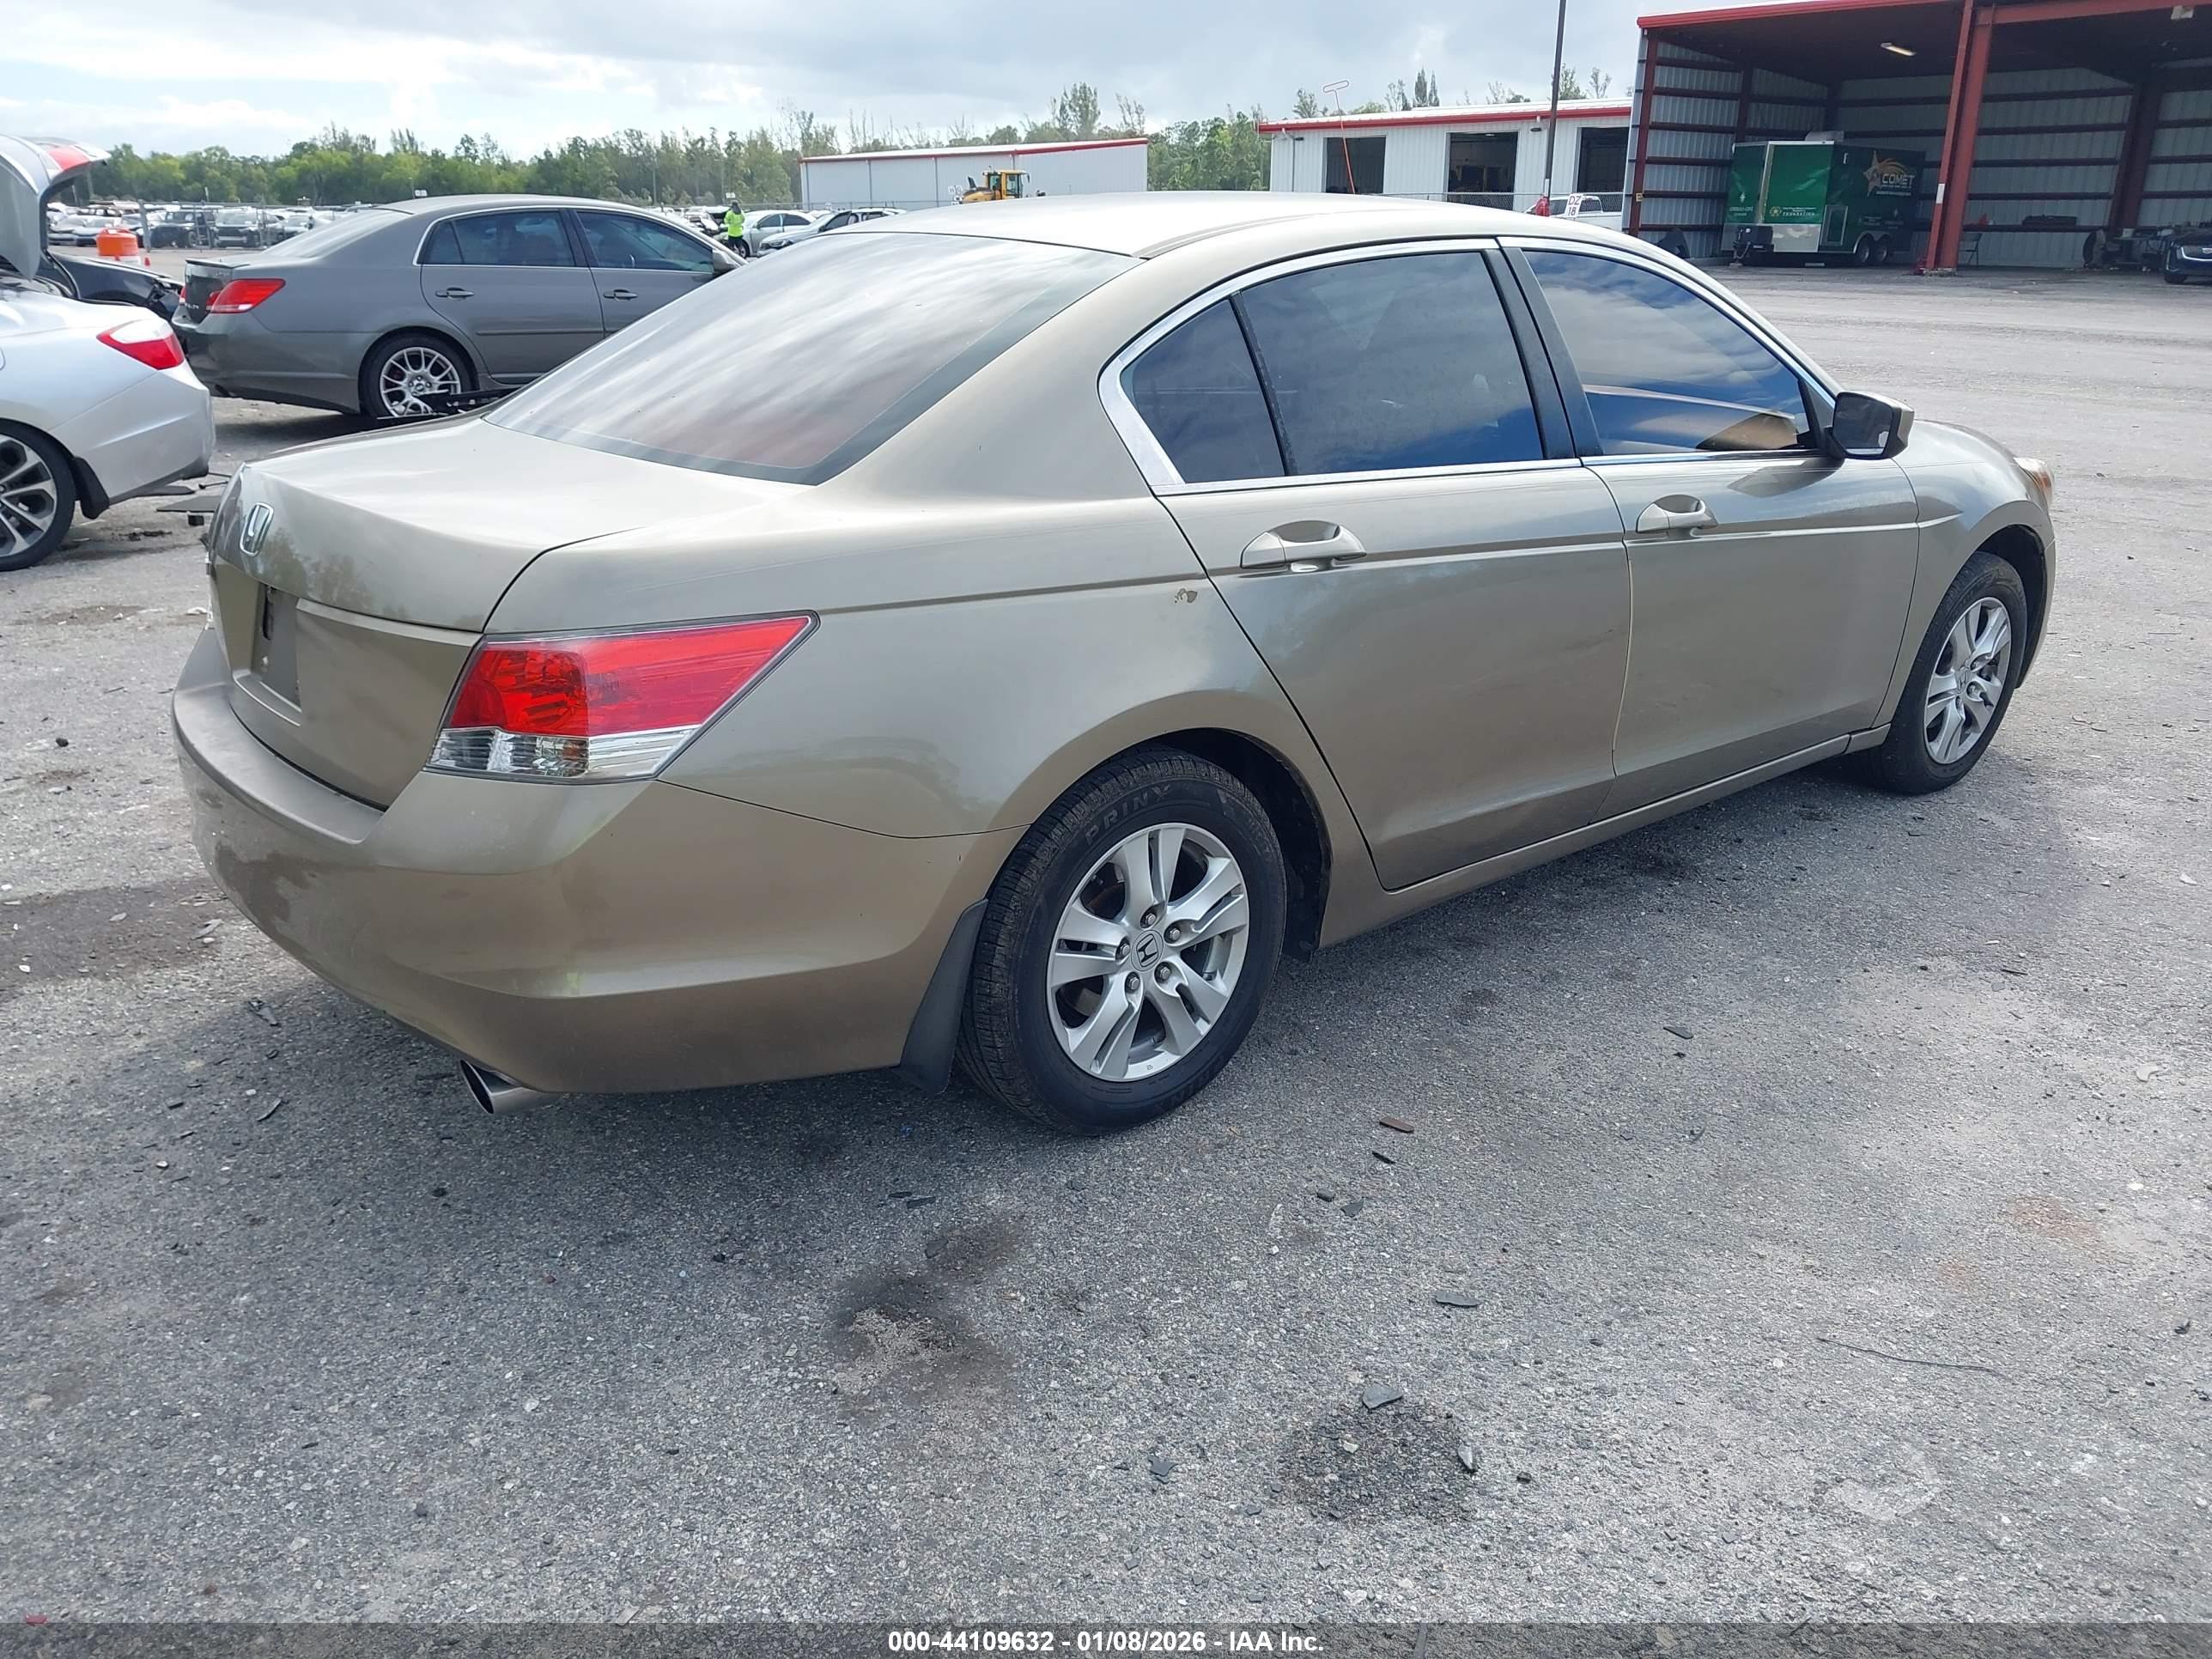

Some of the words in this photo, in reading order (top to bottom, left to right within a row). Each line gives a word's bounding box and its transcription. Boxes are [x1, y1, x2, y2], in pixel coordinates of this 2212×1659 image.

[1882, 173, 1915, 185] COMET
[1569, 196, 1581, 205] DZ
[1568, 207, 1577, 216] 18
